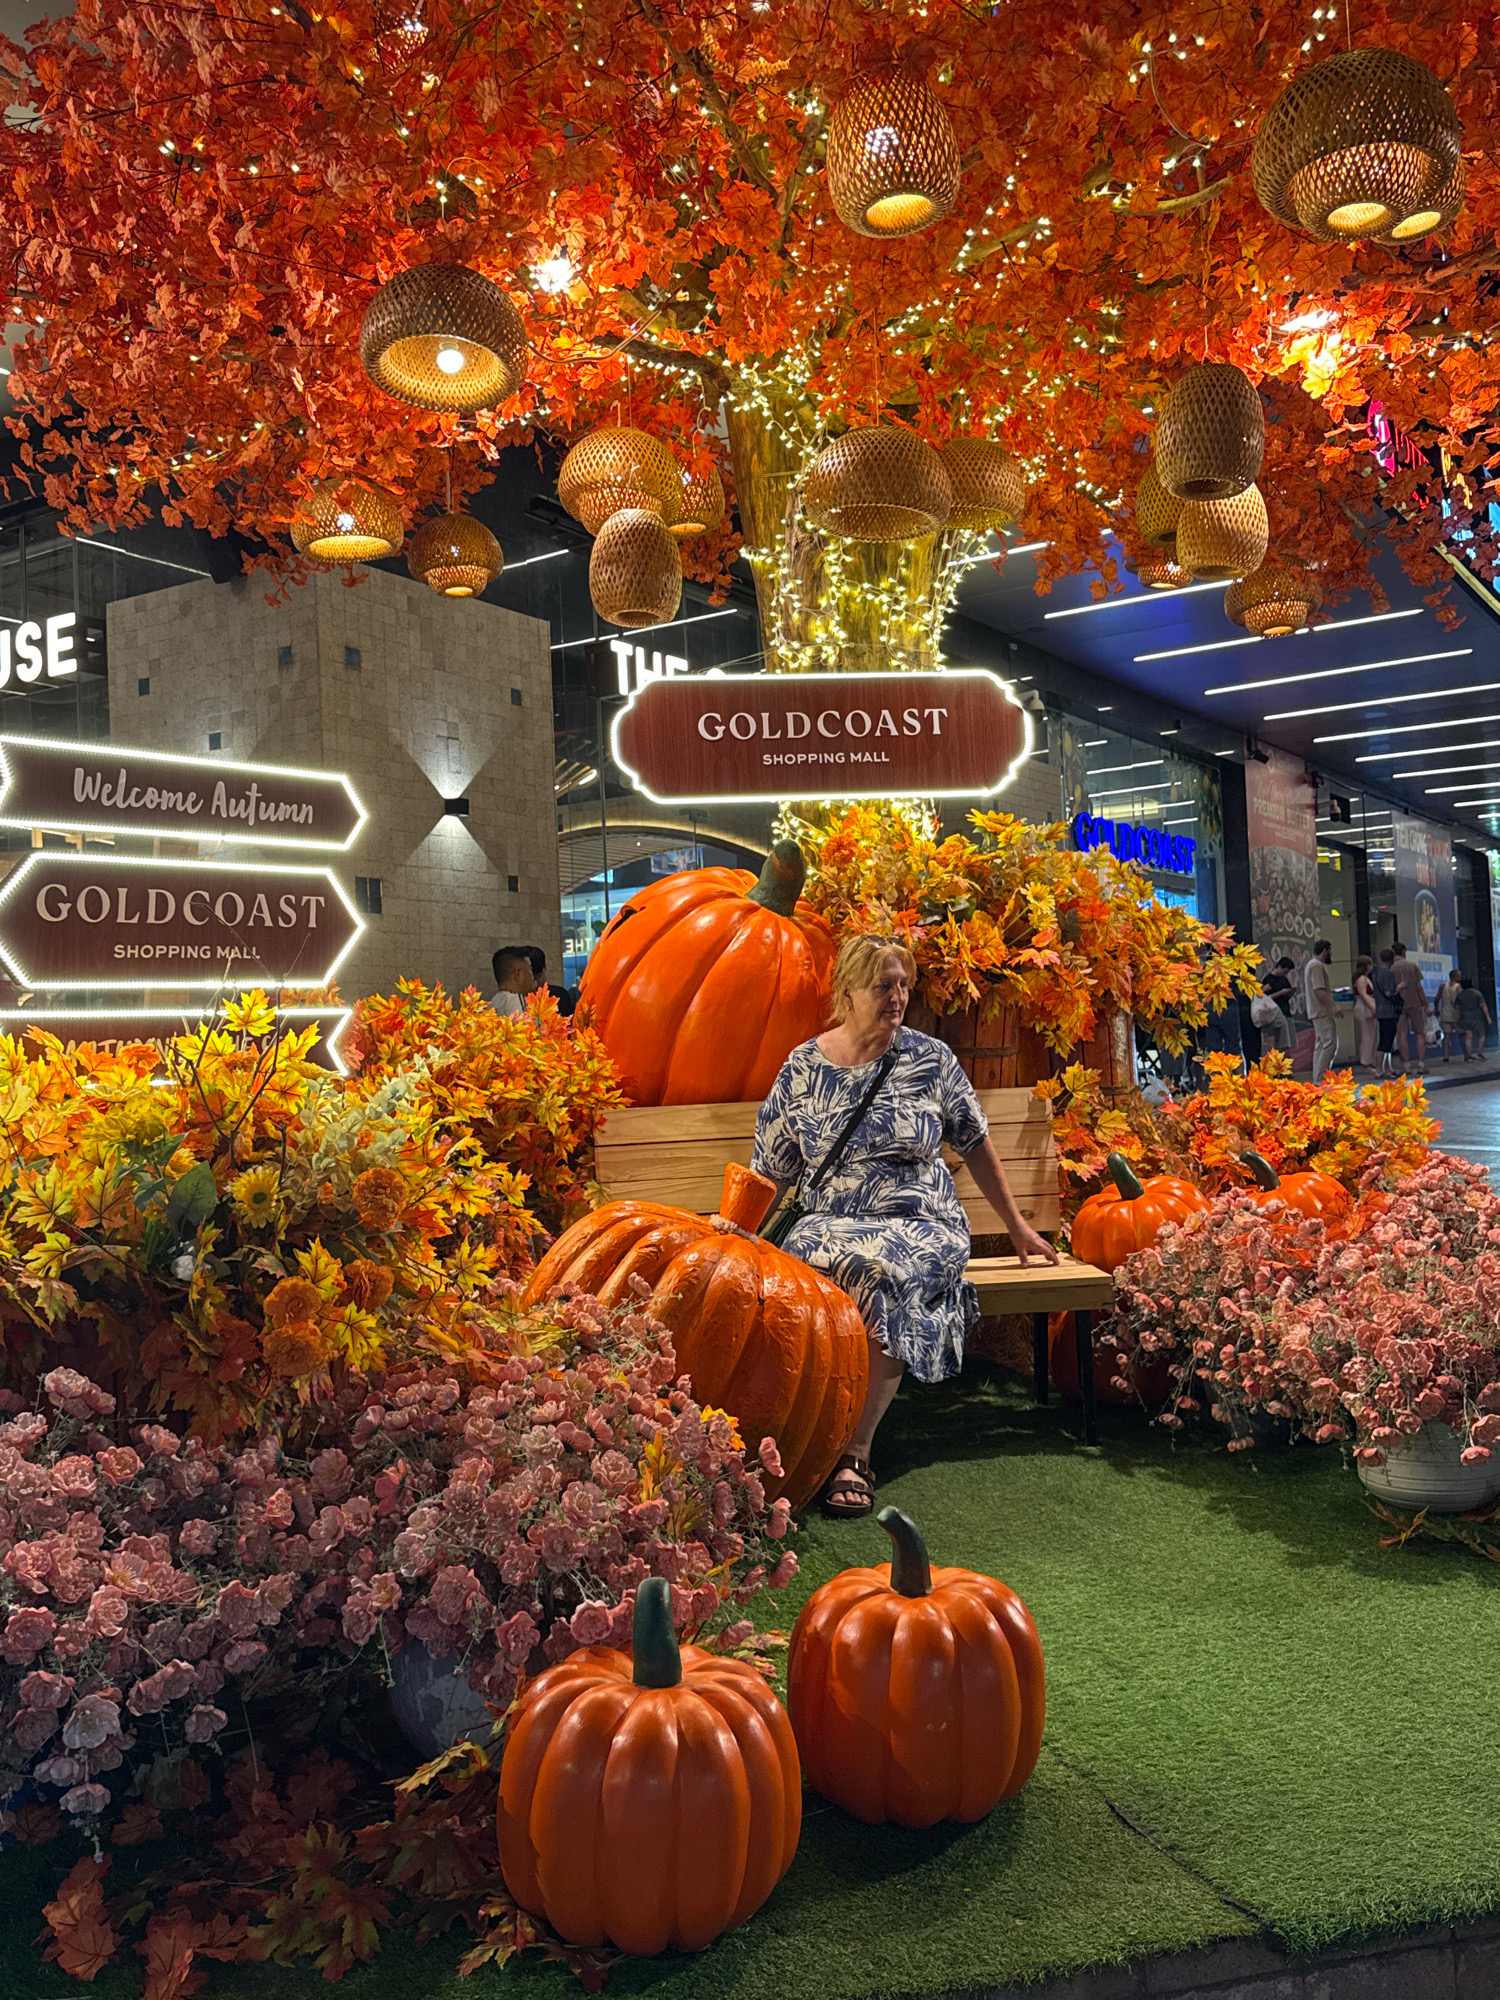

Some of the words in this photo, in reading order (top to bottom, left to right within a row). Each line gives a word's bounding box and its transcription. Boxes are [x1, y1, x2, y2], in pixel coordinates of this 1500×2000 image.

[697, 707, 949, 741] GOLDCOAST
[762, 752, 846, 766] SHOPPING
[849, 751, 890, 764] MALL
[73, 767, 204, 814] Welcome
[211, 780, 314, 826] Autumn
[1077, 811, 1196, 874] GOLDCOAST
[36, 883, 326, 928] GOLDCOAST
[113, 944, 211, 959] SHOPPING
[216, 945, 261, 959] MALL
